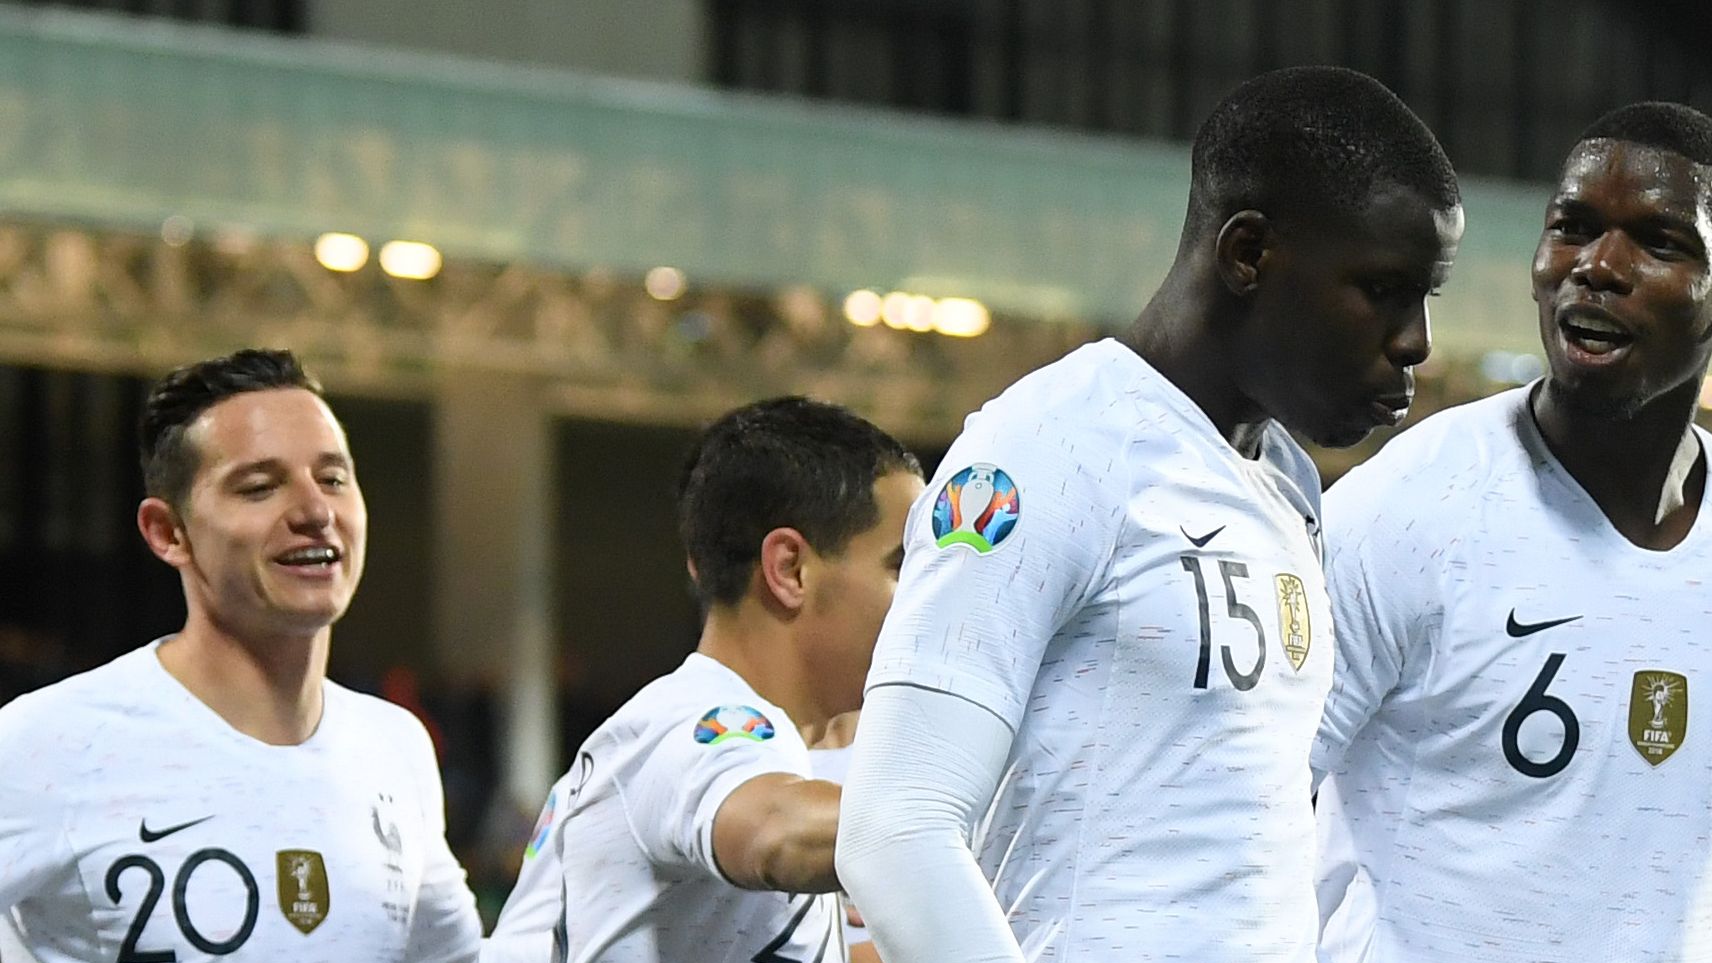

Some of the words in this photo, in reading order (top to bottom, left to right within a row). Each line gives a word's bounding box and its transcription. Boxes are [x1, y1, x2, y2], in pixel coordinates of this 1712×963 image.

[1180, 556, 1267, 691] 15
[1502, 653, 1580, 778] 6
[1643, 729, 1670, 743] FIFA
[292, 902, 318, 914] FIFA
